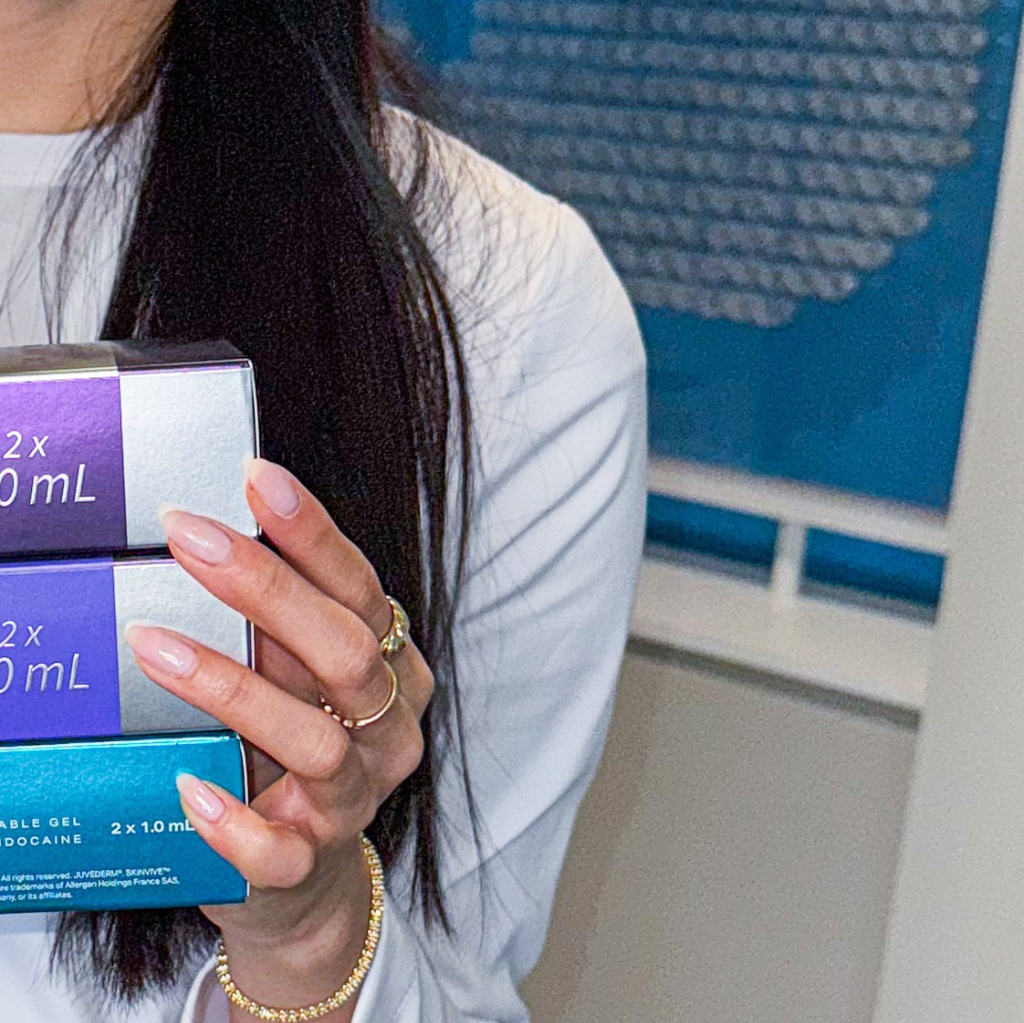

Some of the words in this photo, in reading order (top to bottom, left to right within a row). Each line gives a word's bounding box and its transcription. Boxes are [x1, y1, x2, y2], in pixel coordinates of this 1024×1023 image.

[3, 430, 22, 459] 2
[28, 435, 49, 458] x
[29, 463, 96, 505] mL
[24, 625, 44, 647] x
[25, 653, 89, 692] mL
[49, 817, 81, 828] GEL
[111, 822, 122, 835] 2
[125, 824, 136, 834] x
[141, 820, 164, 834] 1.0
[168, 818, 196, 833] mL
[1, 874, 11, 882] All
[12, 873, 34, 883] rights
[36, 872, 72, 881] reserved.
[10, 883, 54, 891] trademarks
[55, 881, 63, 889] of
[65, 881, 97, 889] Allergan
[98, 879, 132, 888] Holdings
[134, 878, 160, 886] France
[27, 892, 37, 900] its
